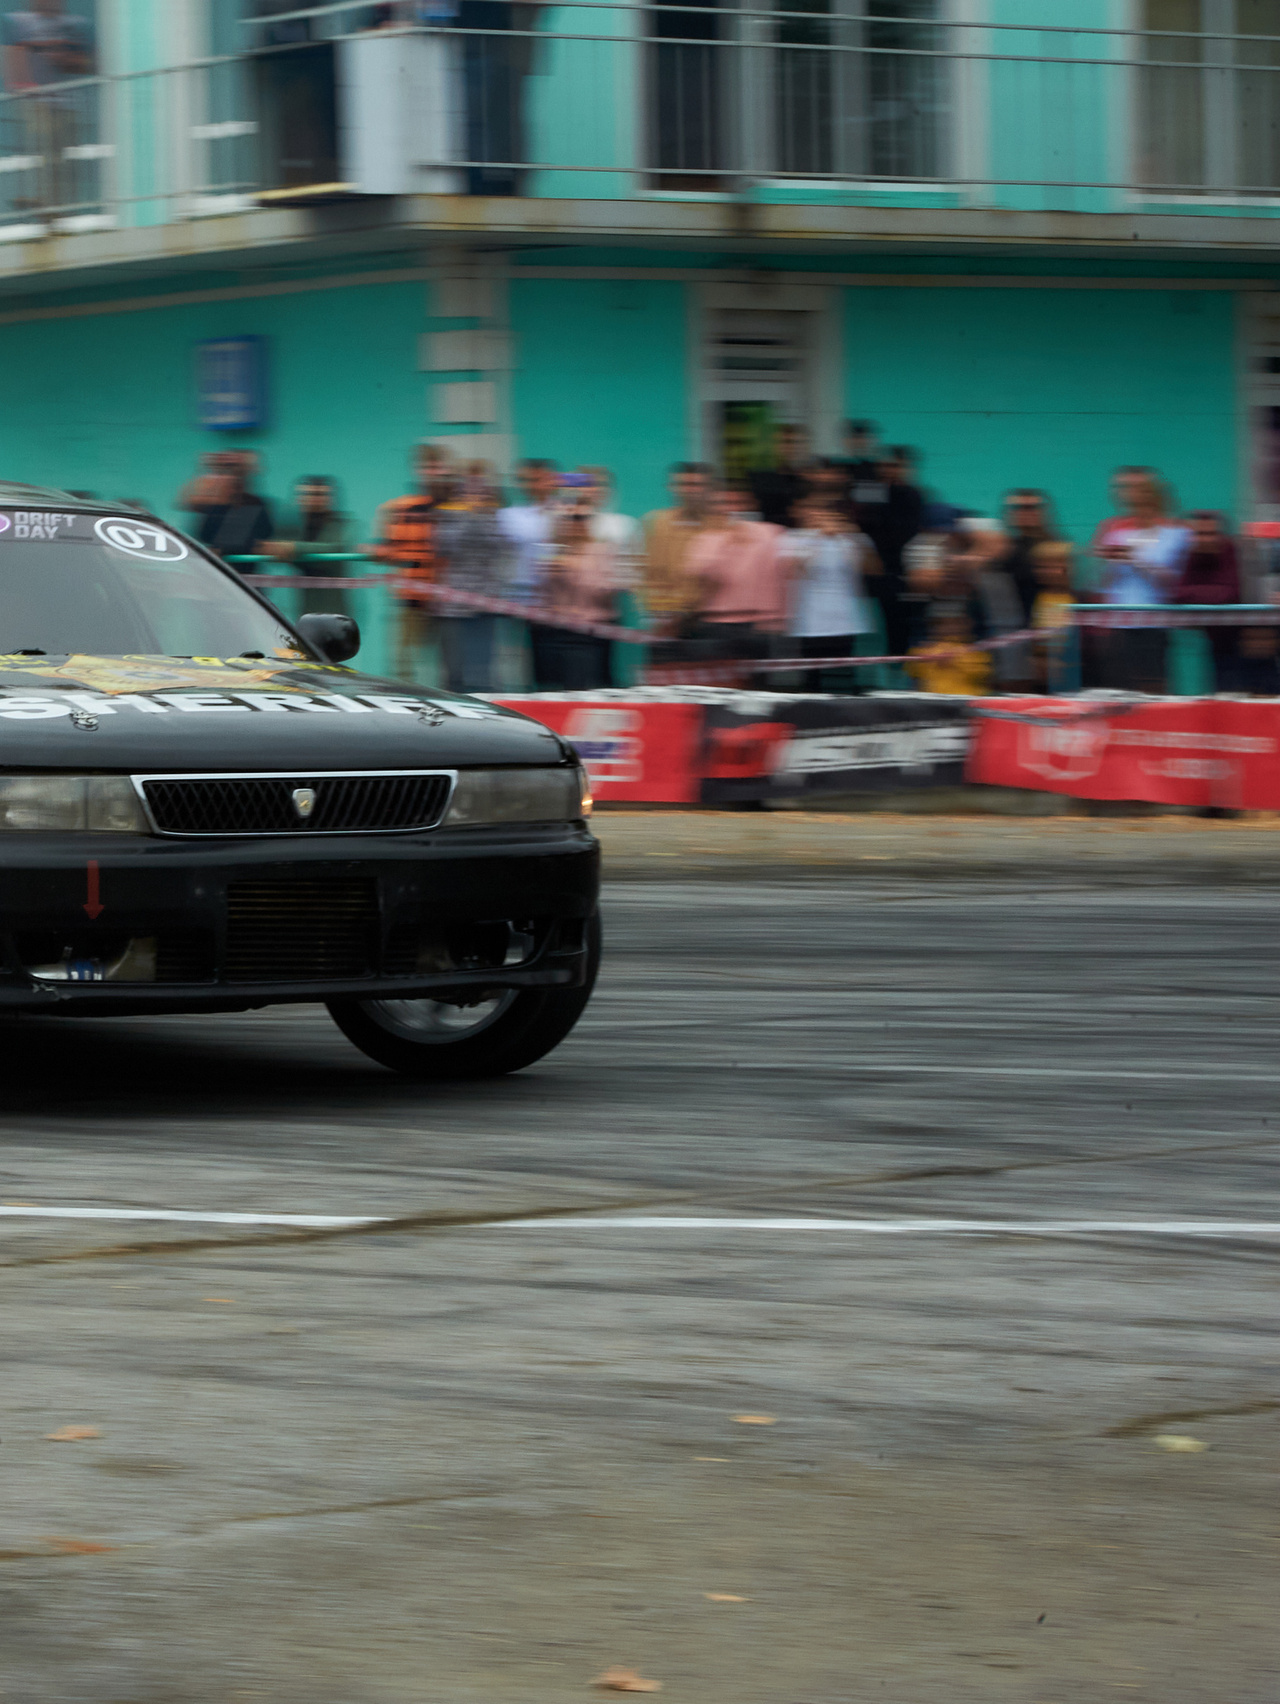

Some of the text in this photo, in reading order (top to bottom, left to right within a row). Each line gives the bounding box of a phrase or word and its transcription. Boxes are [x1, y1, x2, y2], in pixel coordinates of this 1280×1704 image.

[14, 511, 76, 528] DRIFT
[14, 525, 58, 539] DAY
[106, 525, 168, 552] 07
